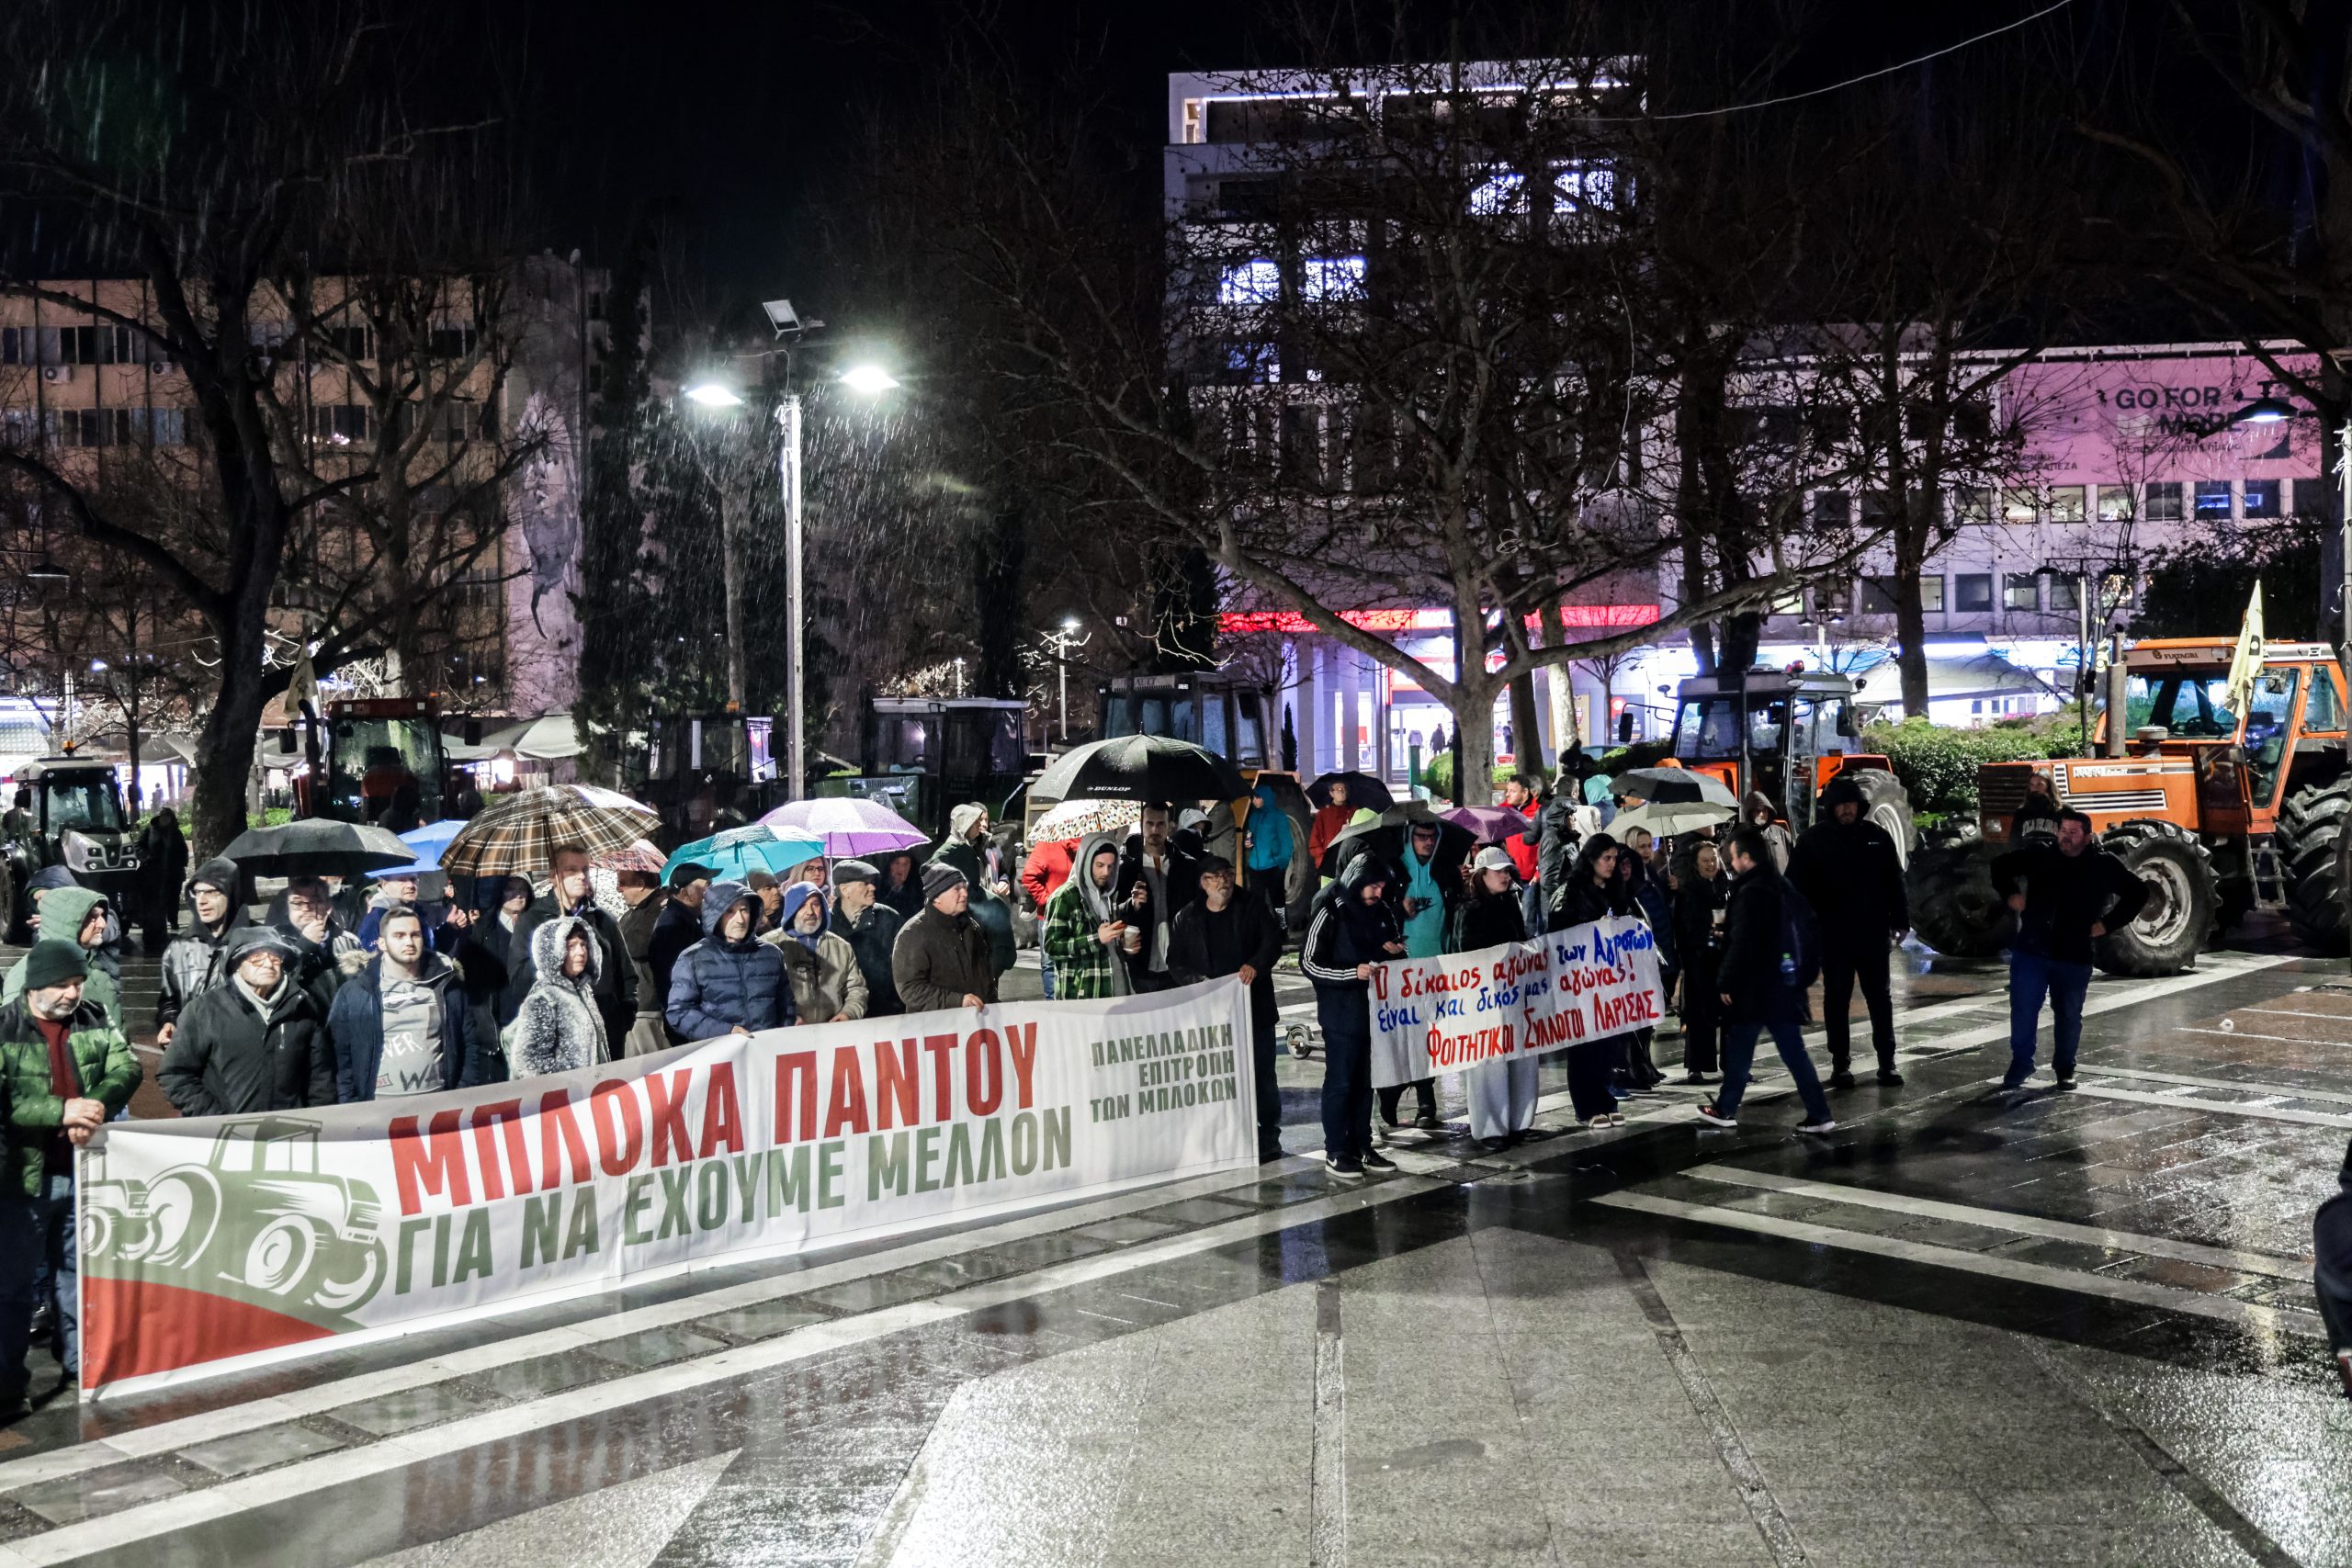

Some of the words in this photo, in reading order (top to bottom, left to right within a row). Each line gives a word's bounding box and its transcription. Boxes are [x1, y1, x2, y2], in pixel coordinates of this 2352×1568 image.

[2115, 388, 2158, 410] GO
[2165, 386, 2222, 409] FOR
[1377, 1000, 1420, 1032] είναι
[1435, 998, 1466, 1021] και
[1476, 982, 1520, 1012] δικός
[1524, 977, 1549, 1008] μας
[1560, 952, 1636, 997] αγώνας!
[1401, 967, 1481, 998] δίκαιος
[1493, 947, 1549, 987] αγώνας
[1556, 944, 1587, 965] των
[1593, 921, 1654, 967] Αγροτών
[1091, 1022, 1233, 1067] ΠΑΝΕΛΛΑΔΙΚΗ
[1426, 1022, 1515, 1069] ΦΟΙΤΗΤΙΚΟΙ
[1523, 1007, 1586, 1049] ΣΥΛΛΟΓΟΙ
[1593, 989, 1660, 1032] ΛΑΡΙΣΑΣ
[1090, 1093, 1130, 1123] ΤΩΝ
[1138, 1076, 1238, 1115] ΜΠΛΟΚΩΝ
[1138, 1049, 1236, 1088] ΕΠΙΤΡΟΠΗ
[388, 1060, 745, 1217] ΜΠΛΟΚΑ
[774, 1021, 1038, 1145] ΠΑΝΤΟΥ
[394, 1206, 493, 1296] ΓΙΑ
[519, 1185, 600, 1270] ΝΑ
[624, 1140, 845, 1247] ΕΧΟΥΜΕ
[867, 1105, 1072, 1202] ΜΕΛΛΟΝ
